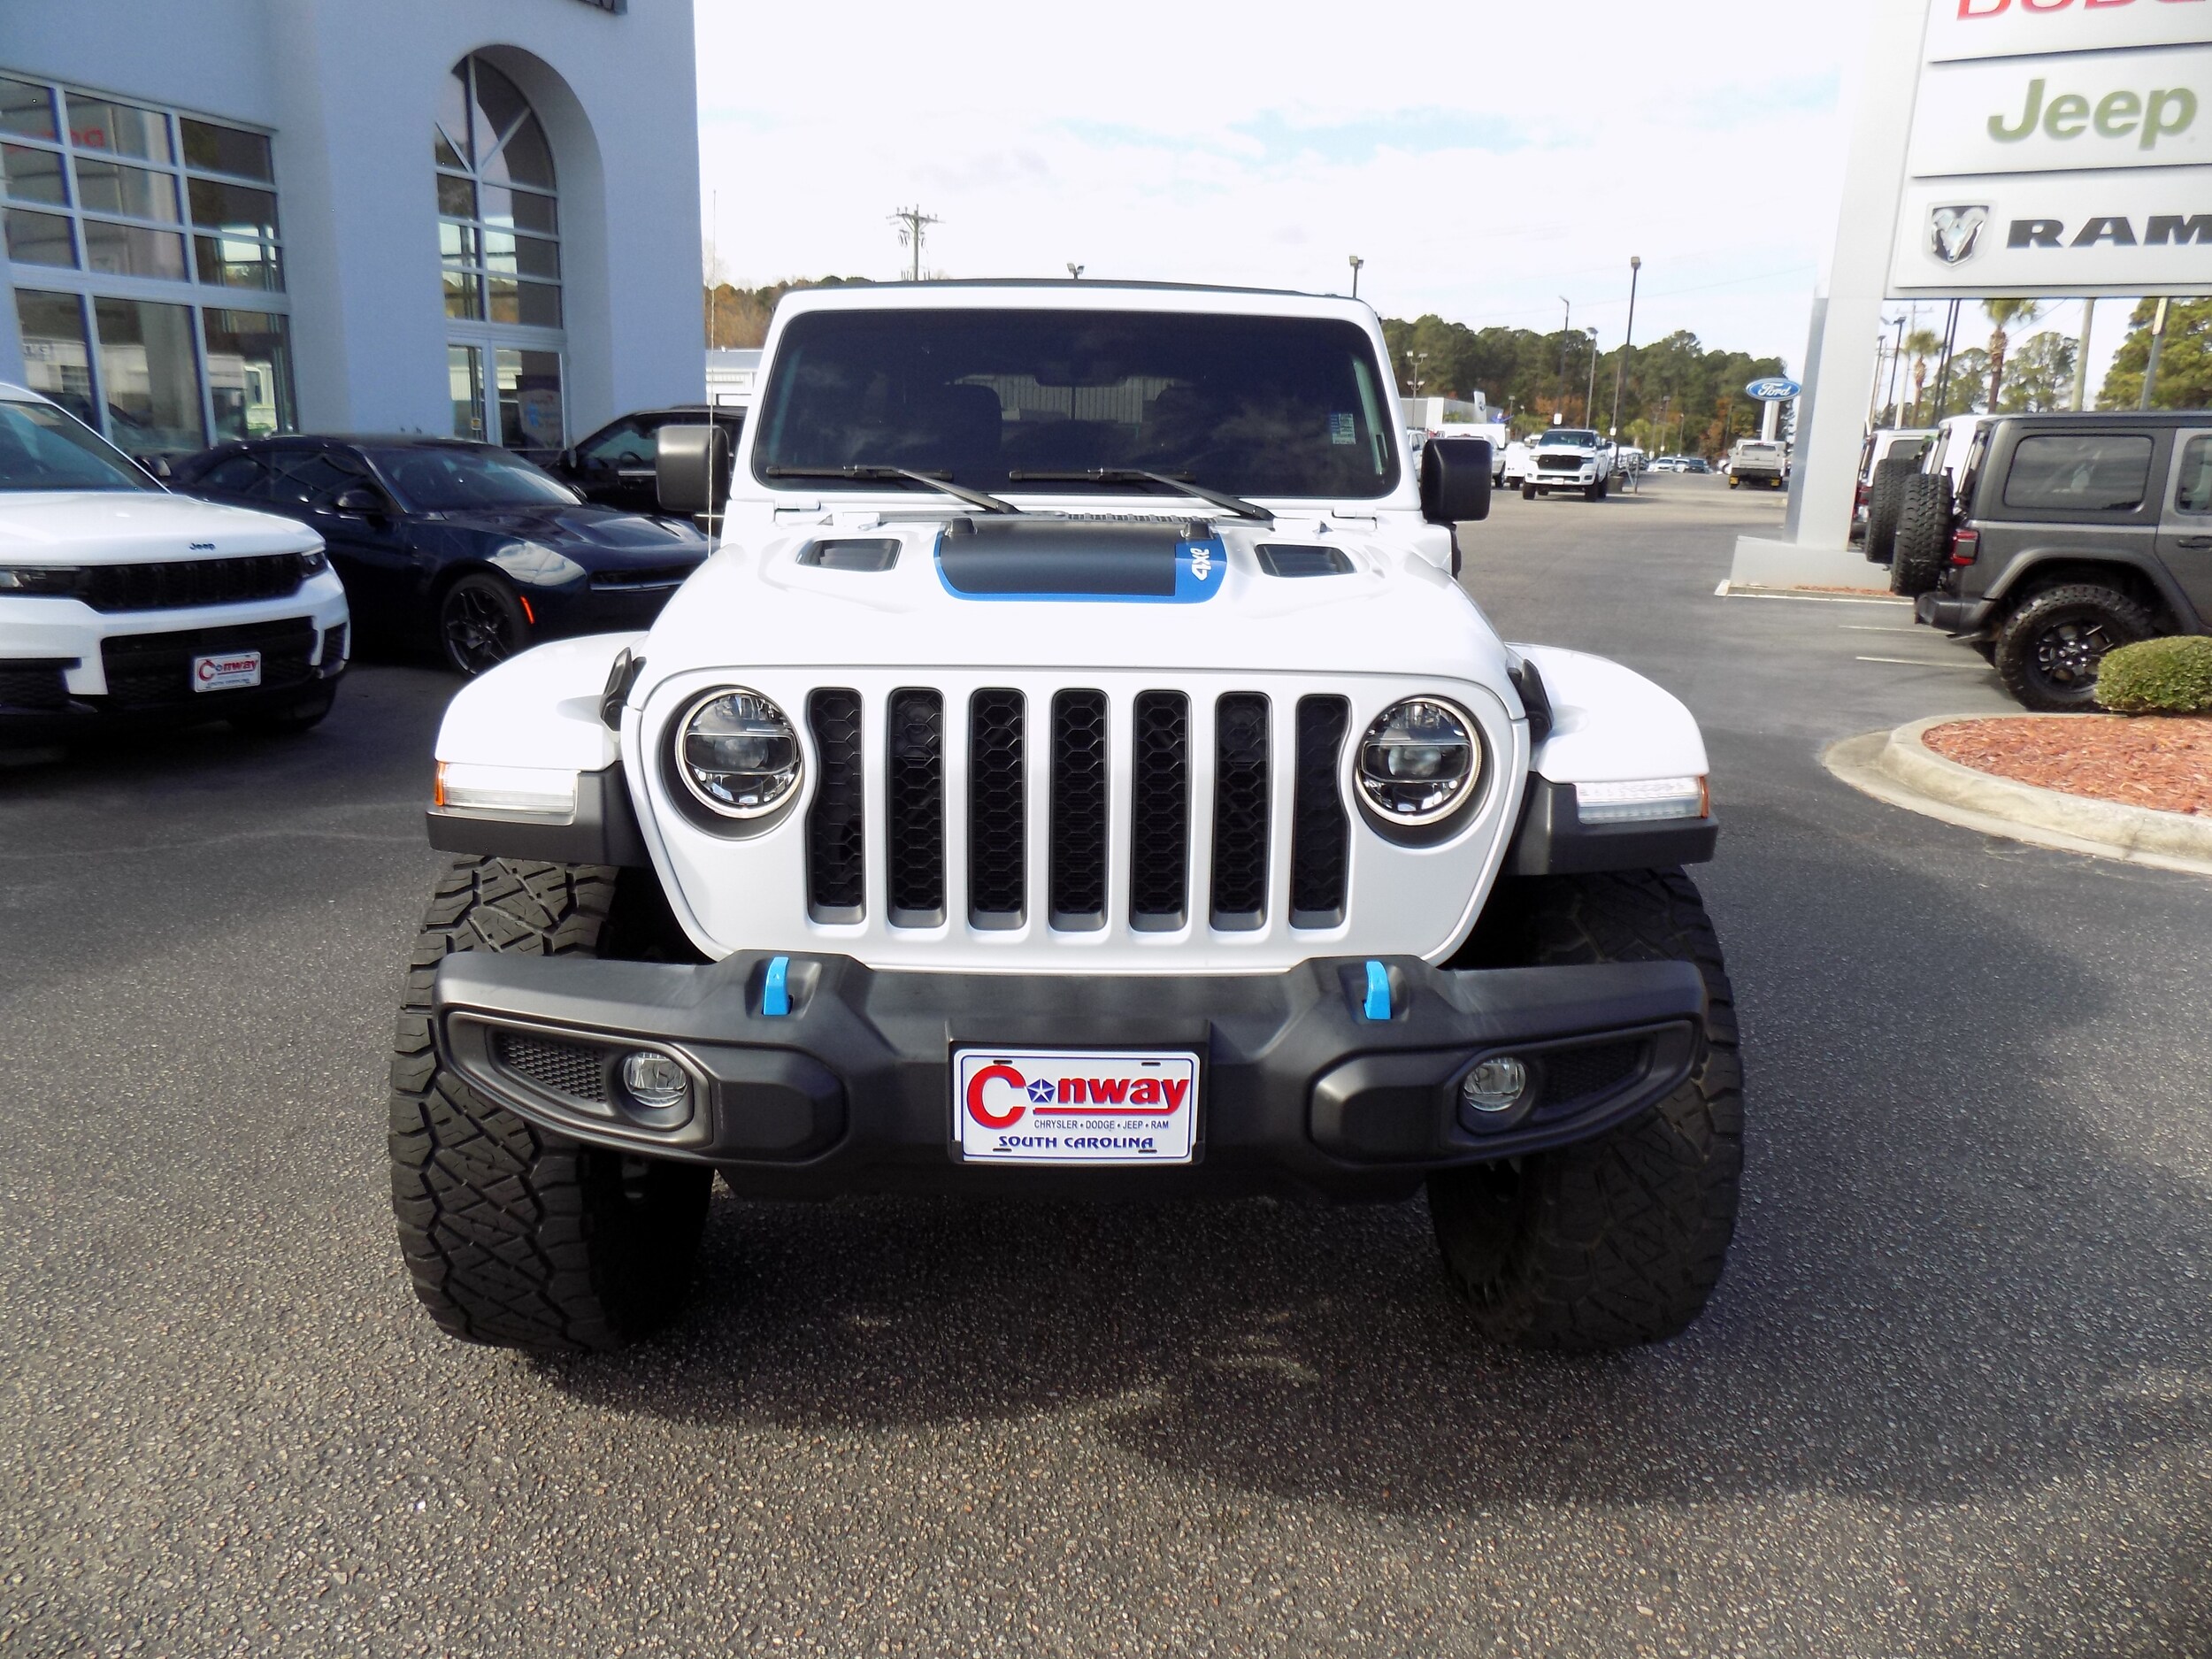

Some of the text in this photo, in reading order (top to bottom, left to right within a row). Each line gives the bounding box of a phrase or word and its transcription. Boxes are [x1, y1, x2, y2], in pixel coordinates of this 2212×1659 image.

[1987, 79, 2198, 150] Jeep
[2007, 214, 2212, 249] RAM
[1757, 382, 1792, 396] Ford
[1033, 1119, 1169, 1130] CHRYSLER DODGE JEEP RAM
[998, 1136, 1154, 1149] SOUTH CAROLINA
